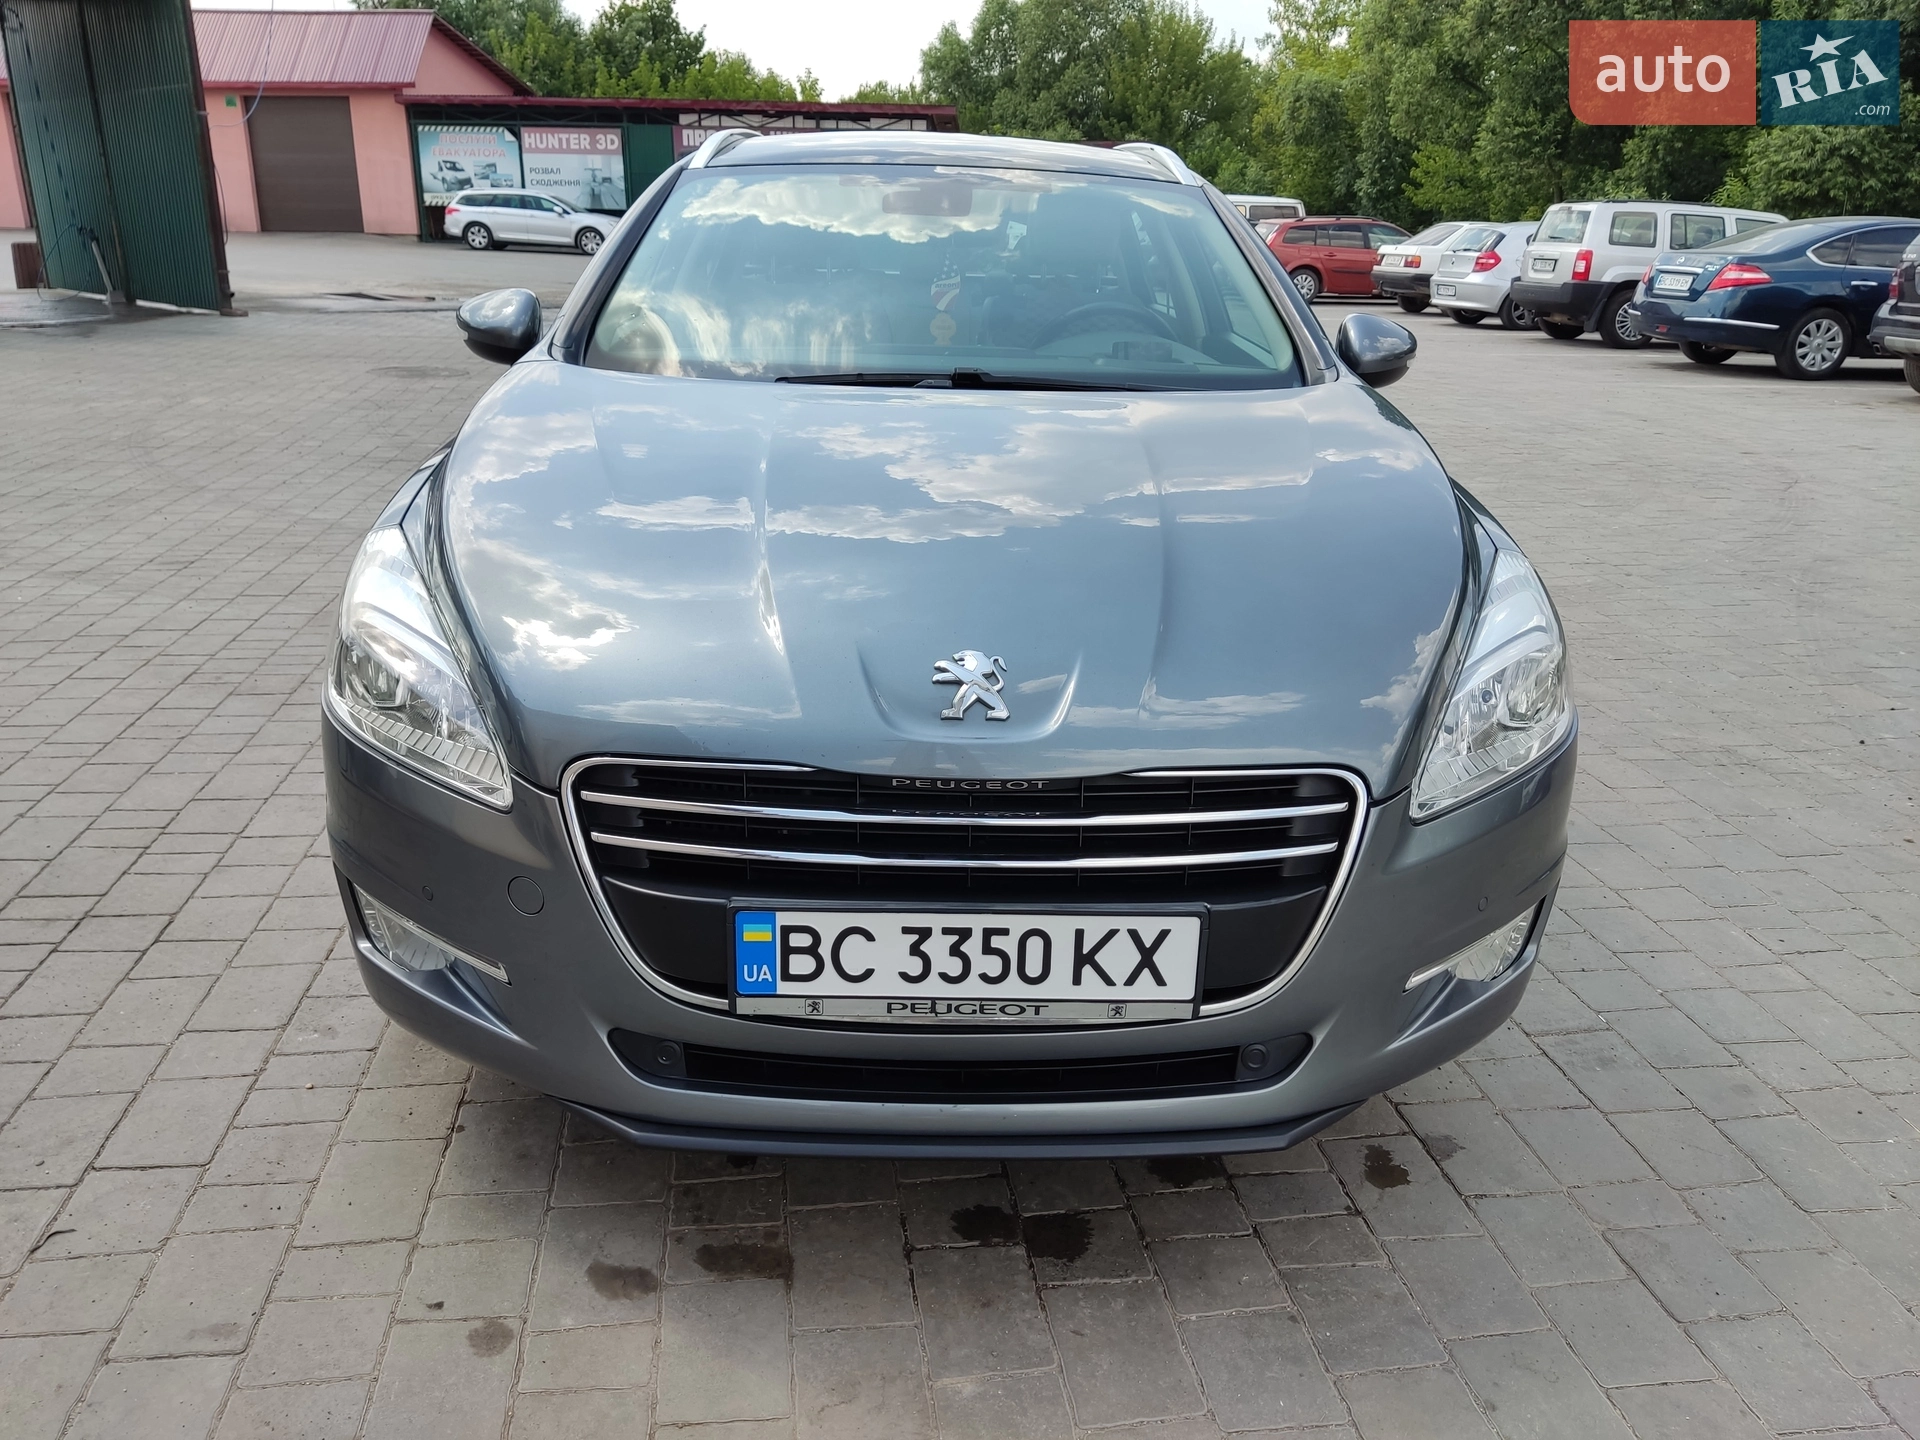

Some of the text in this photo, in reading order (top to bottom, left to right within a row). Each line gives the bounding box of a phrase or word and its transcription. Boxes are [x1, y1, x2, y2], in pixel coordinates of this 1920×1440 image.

[439, 133, 497, 145] ПОСЛУГИ
[524, 133, 619, 150] HUNTER 3D
[431, 146, 506, 158] ЕВАКУАТОРА
[529, 167, 561, 175] РОЗВАЛ
[530, 178, 581, 187] СХОДЖЕННЯ
[892, 778, 1050, 790] PEUGEOT
[779, 924, 1172, 987] BC 3350 KX
[743, 964, 773, 982] UA
[886, 1001, 1049, 1017] PEUGEOT
